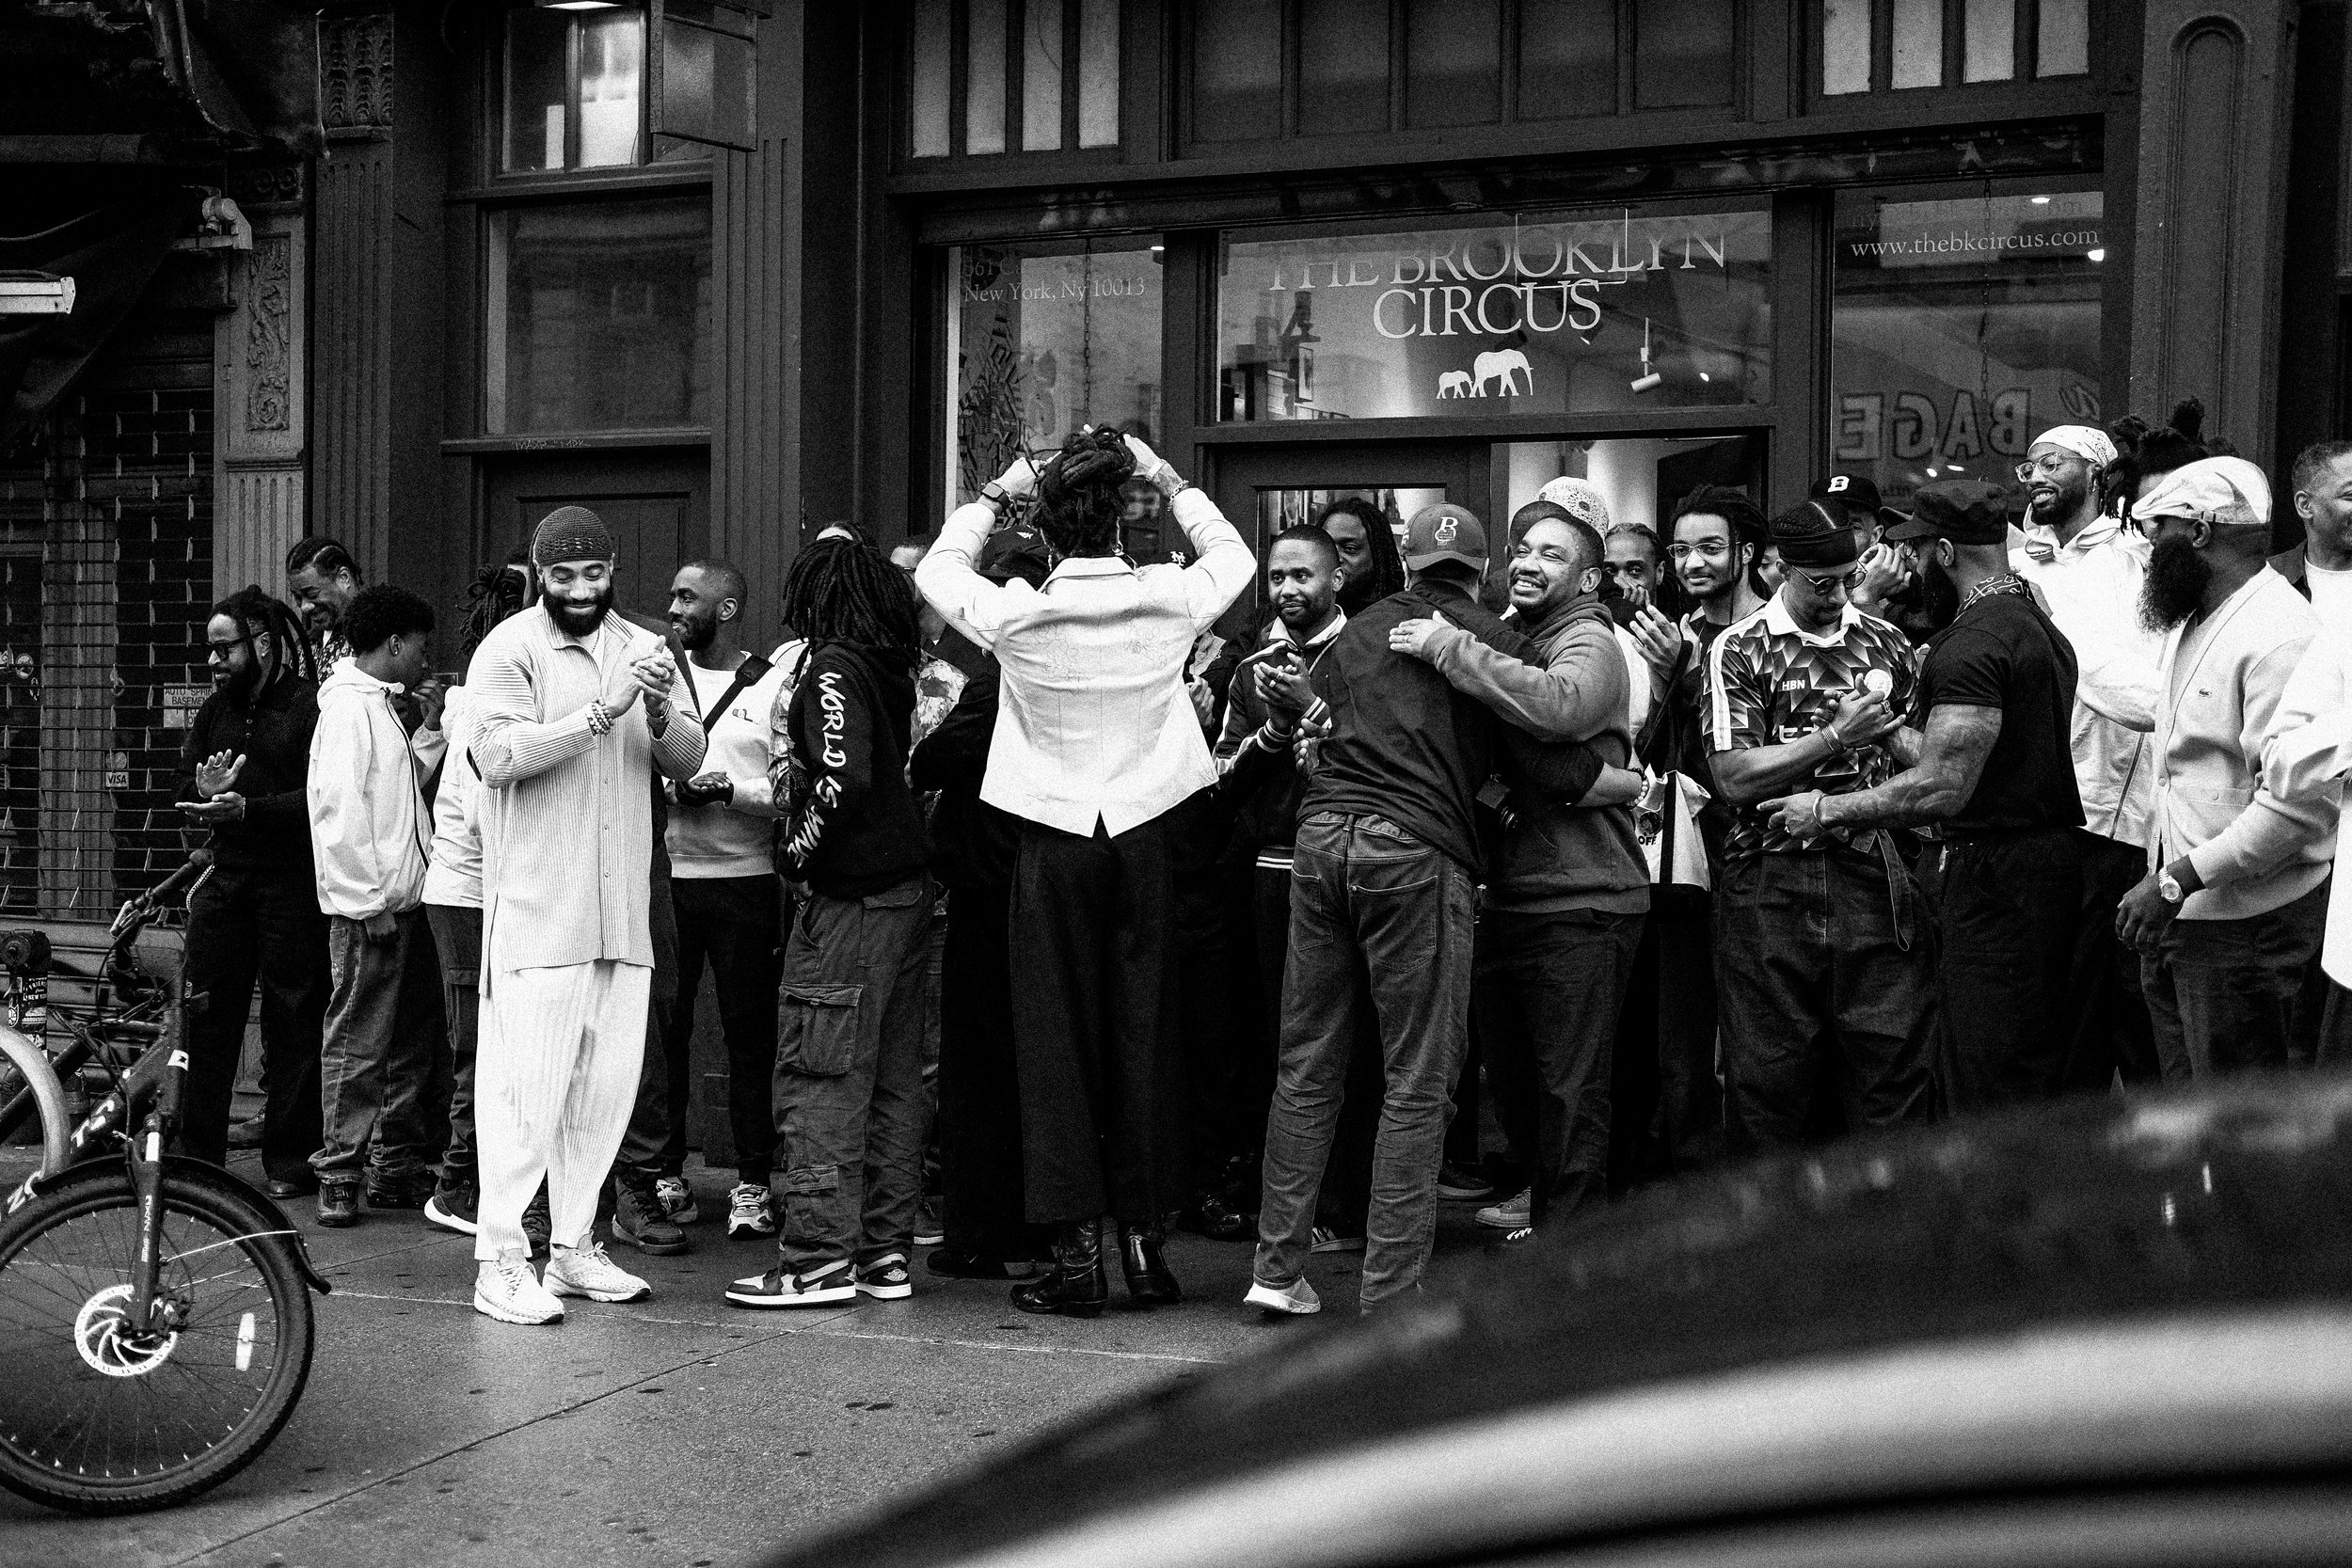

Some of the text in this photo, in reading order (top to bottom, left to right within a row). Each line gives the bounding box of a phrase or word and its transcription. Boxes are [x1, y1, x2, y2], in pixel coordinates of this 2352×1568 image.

[1851, 228, 2100, 258] www.thebkcircus.com
[1269, 231, 1725, 290] THE BROOKLYN
[963, 277, 1145, 302] New York, Ny 10013
[1373, 278, 1601, 339] CIRCUS
[1782, 679, 1805, 691] HBN
[818, 672, 848, 768] WORLD
[107, 774, 127, 784] VISA
[816, 775, 842, 809] IS
